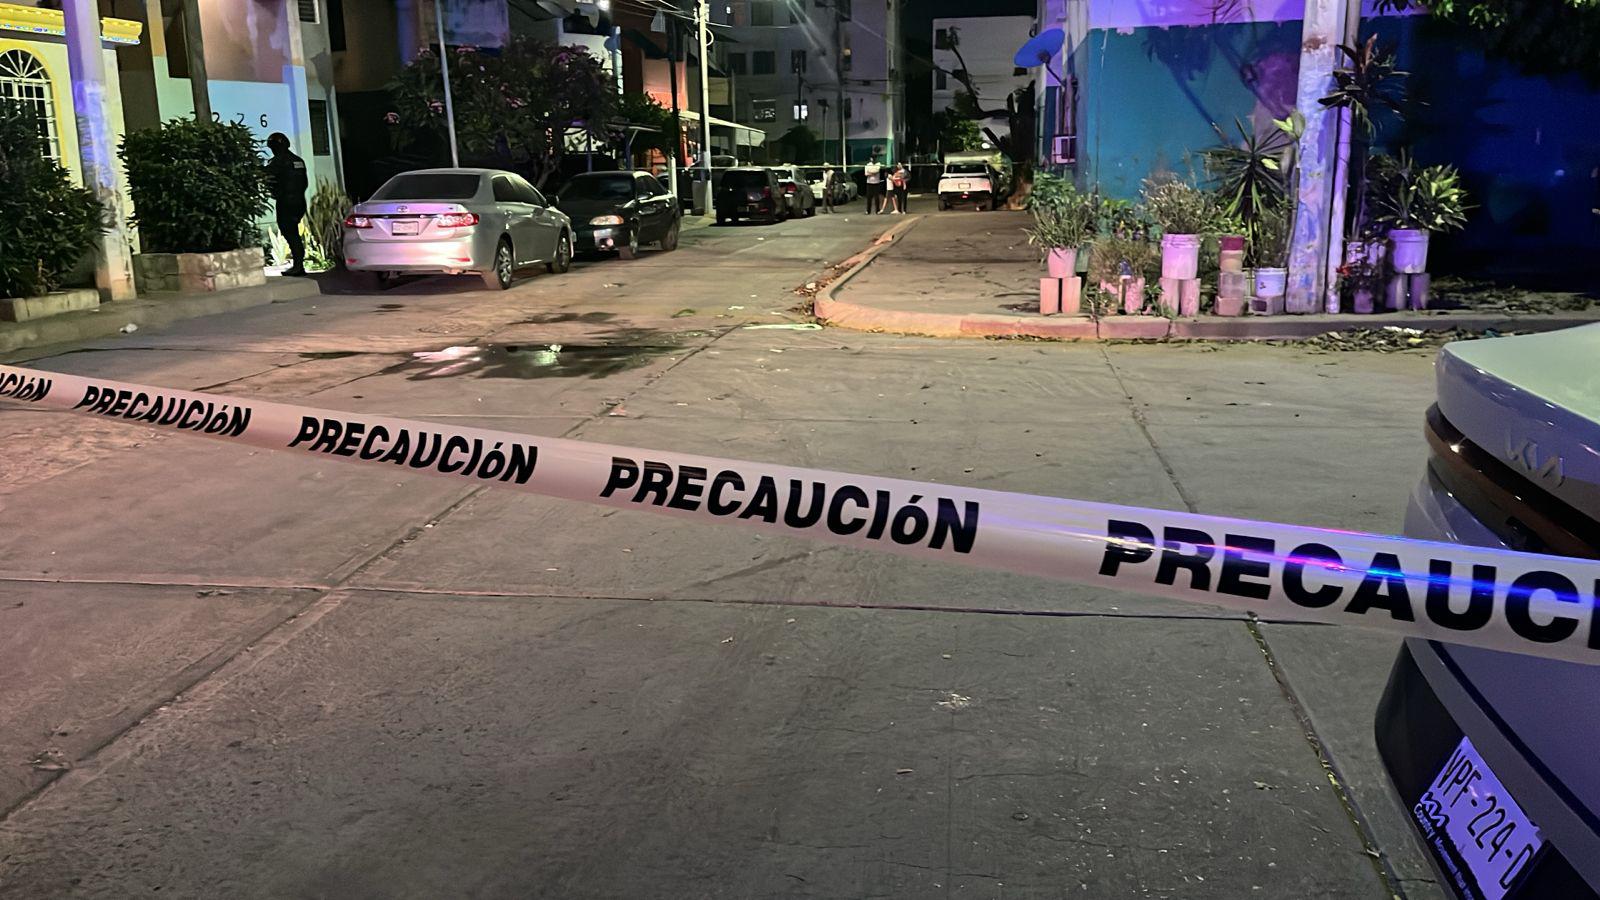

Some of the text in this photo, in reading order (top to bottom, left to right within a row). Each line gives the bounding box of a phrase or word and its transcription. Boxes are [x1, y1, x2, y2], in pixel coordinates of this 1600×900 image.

[72, 386, 252, 436] PRECAUCIóN
[287, 416, 538, 484] PRECAUCIóN
[600, 456, 980, 554] PRECAUCIóN
[1503, 431, 1566, 488] KIA
[1437, 748, 1535, 890] VPF-224-D
